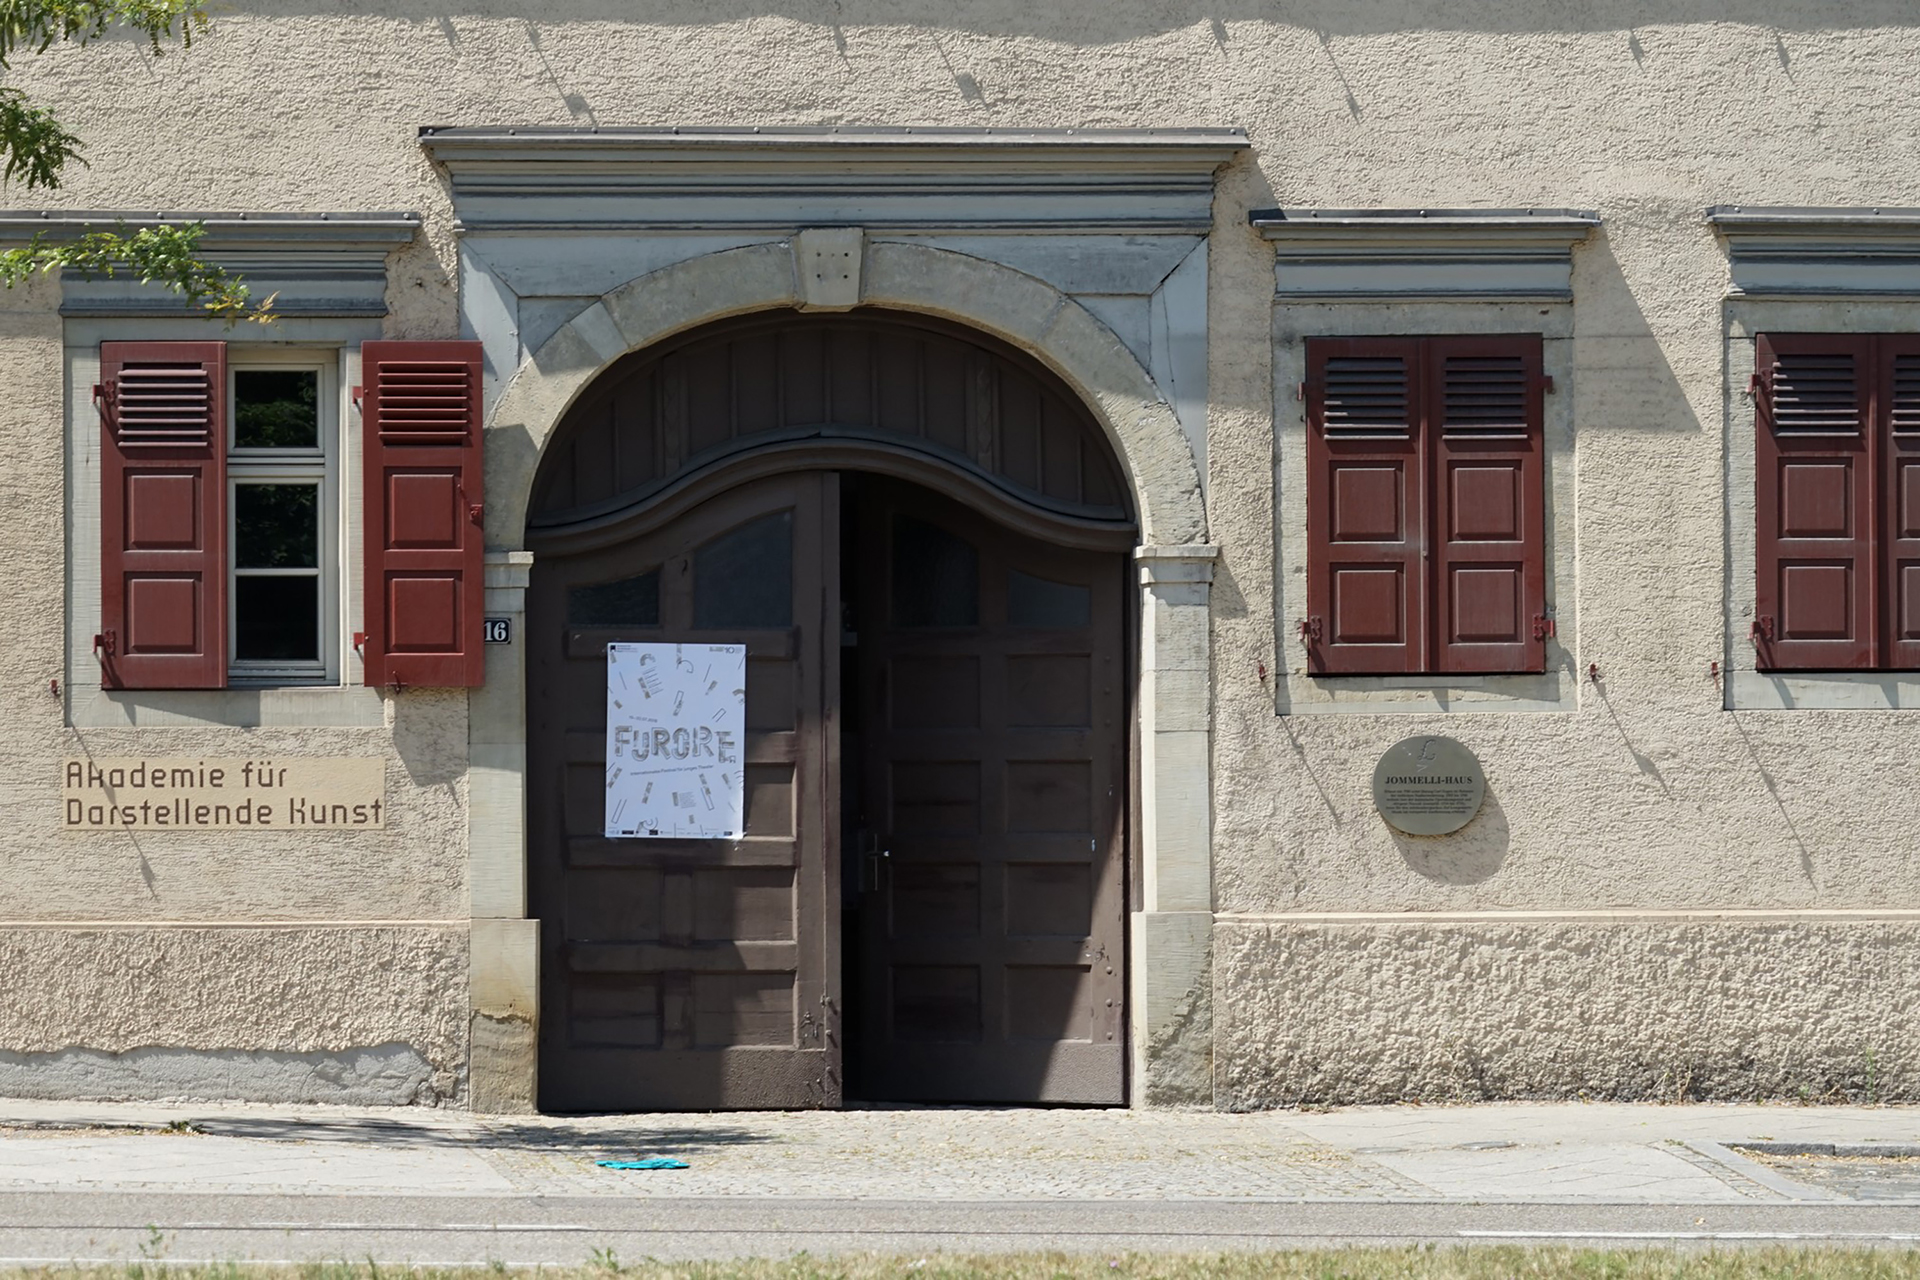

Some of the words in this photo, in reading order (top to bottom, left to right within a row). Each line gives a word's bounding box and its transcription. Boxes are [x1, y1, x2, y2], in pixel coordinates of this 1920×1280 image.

[484, 621, 507, 641] 16
[614, 725, 736, 763] FURORE
[66, 761, 225, 788] Akademie
[241, 761, 287, 788] für
[1385, 776, 1473, 785] JOMMELLI-HAUS
[66, 798, 272, 825] Darstellende
[289, 797, 382, 825] Kunst
